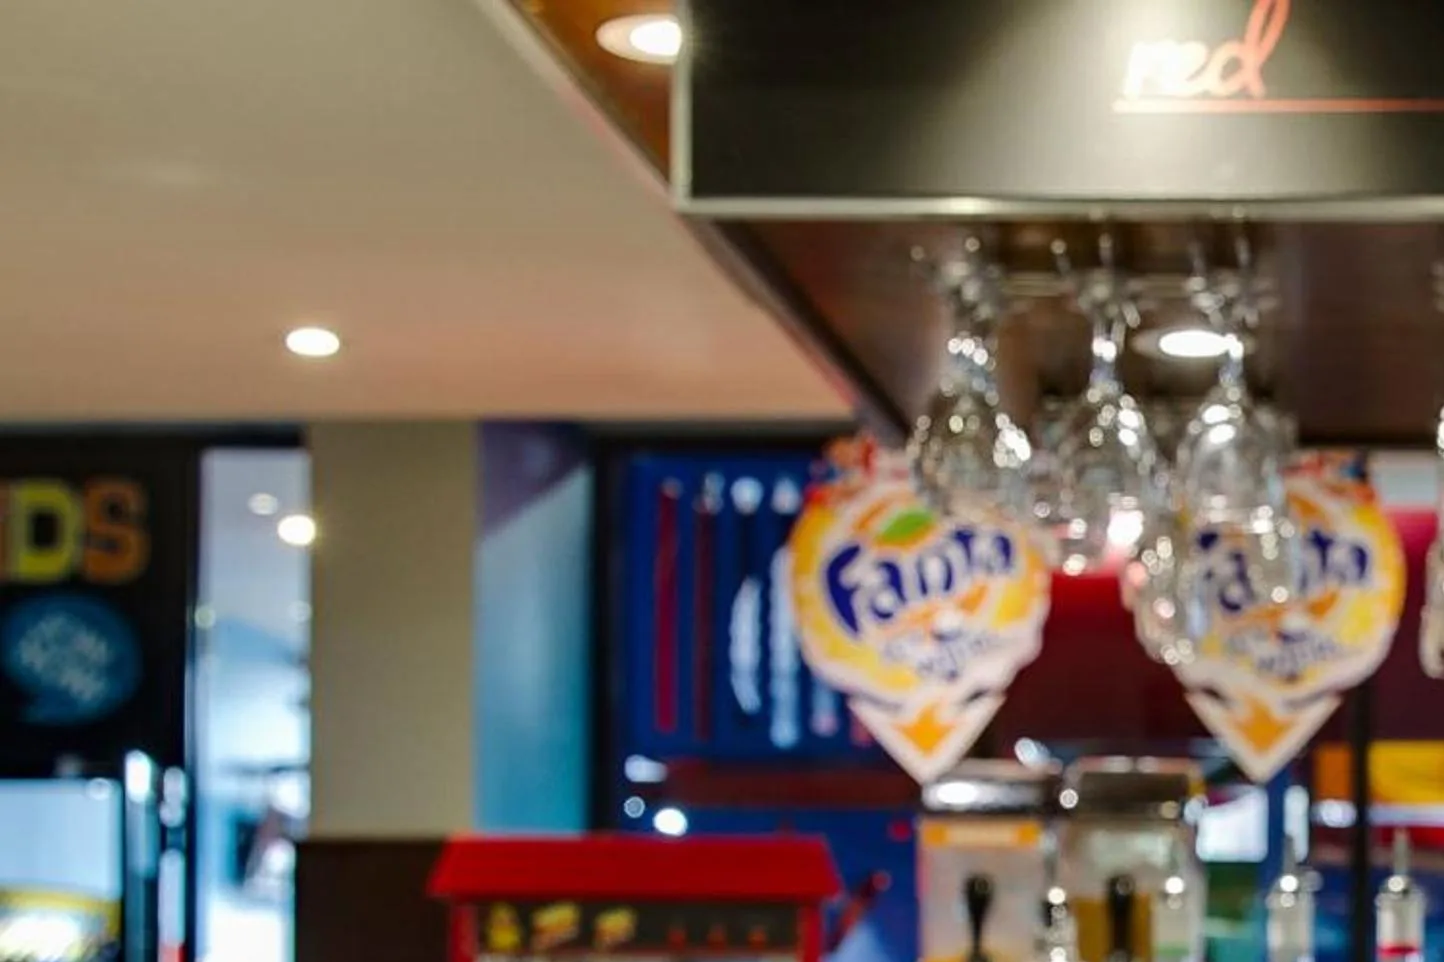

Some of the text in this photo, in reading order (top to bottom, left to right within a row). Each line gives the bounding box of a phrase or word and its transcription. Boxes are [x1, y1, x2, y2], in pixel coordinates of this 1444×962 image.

[1122, 0, 1292, 100] red
[0, 477, 151, 583] DS
[824, 525, 1013, 638] Fanta
